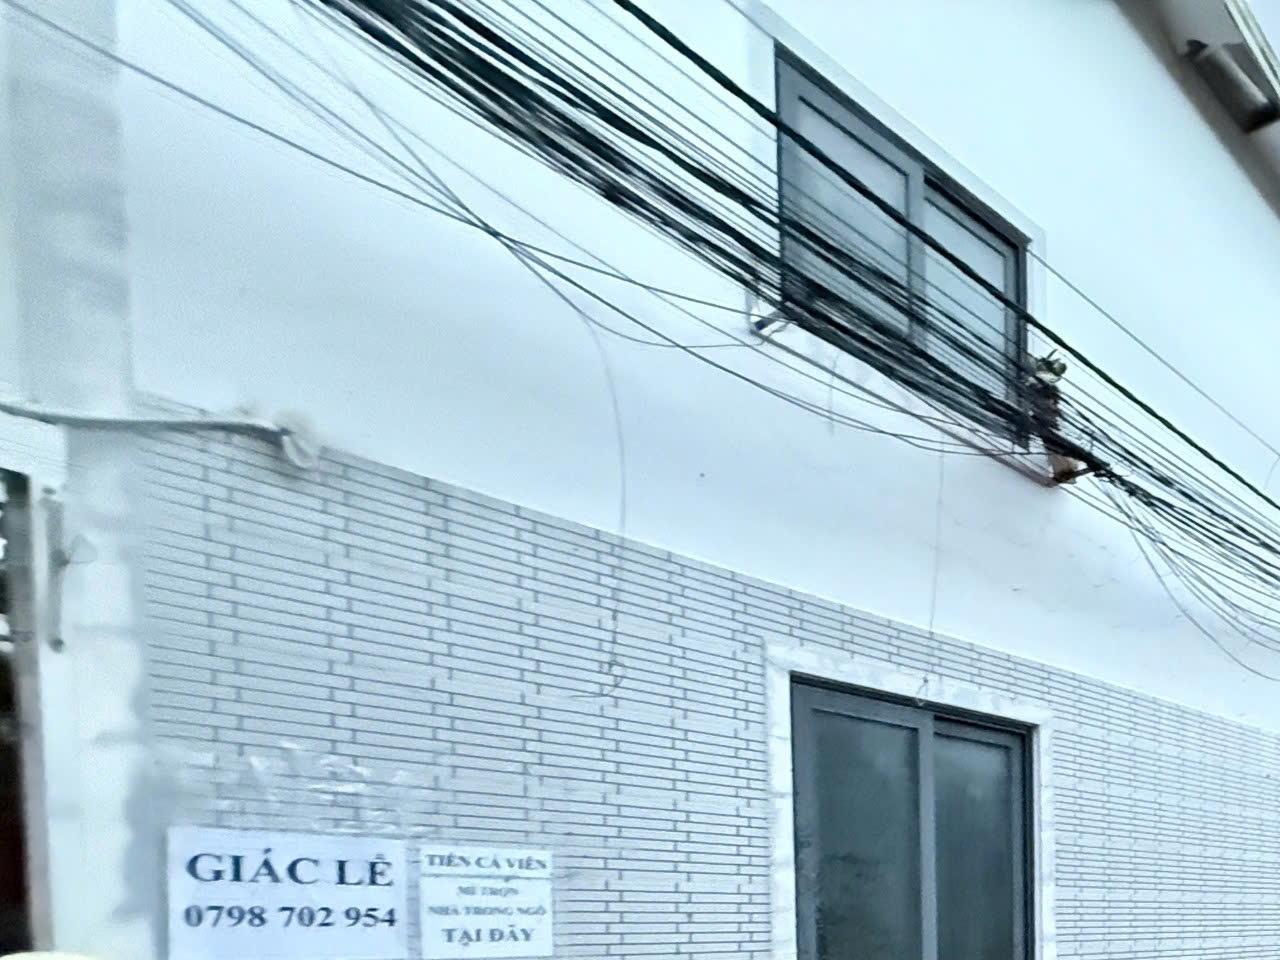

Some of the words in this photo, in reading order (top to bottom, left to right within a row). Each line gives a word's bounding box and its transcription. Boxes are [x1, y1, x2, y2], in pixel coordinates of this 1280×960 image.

[186, 847, 320, 884] GIÁC
[184, 905, 267, 927] 0798
[278, 906, 335, 927] 702
[343, 907, 397, 927] 954
[441, 927, 482, 946] TẠI
